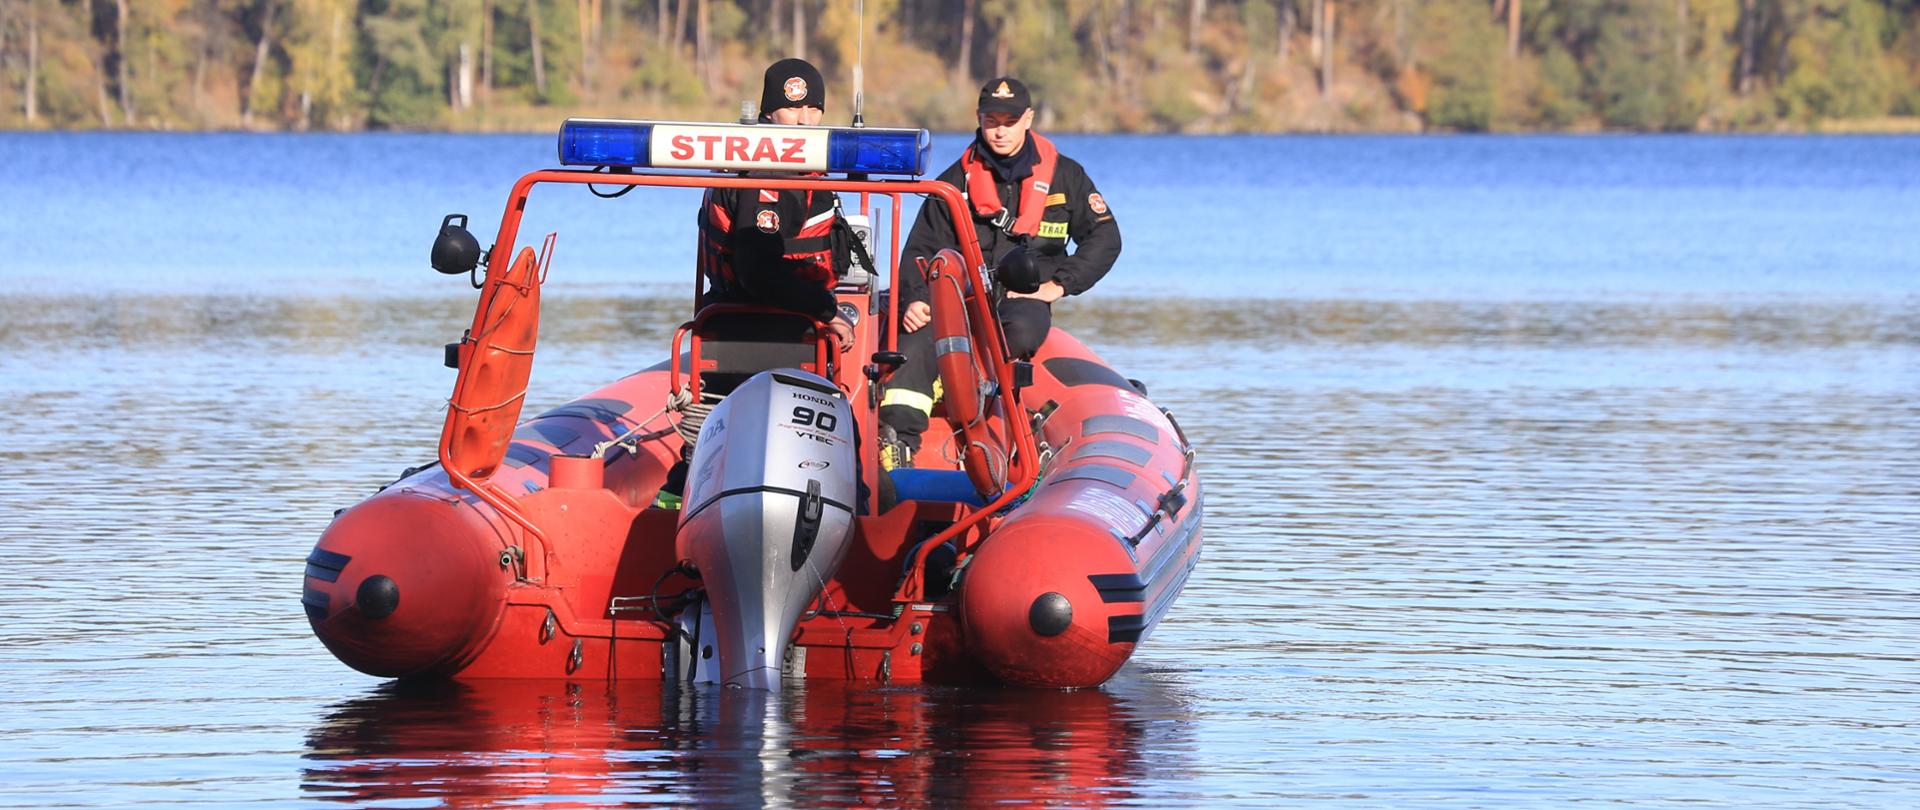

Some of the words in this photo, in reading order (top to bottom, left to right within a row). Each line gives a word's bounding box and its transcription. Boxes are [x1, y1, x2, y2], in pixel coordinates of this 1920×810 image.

[793, 392, 836, 409] HONDA
[791, 406, 837, 432] 90
[795, 430, 834, 446] VTEC
